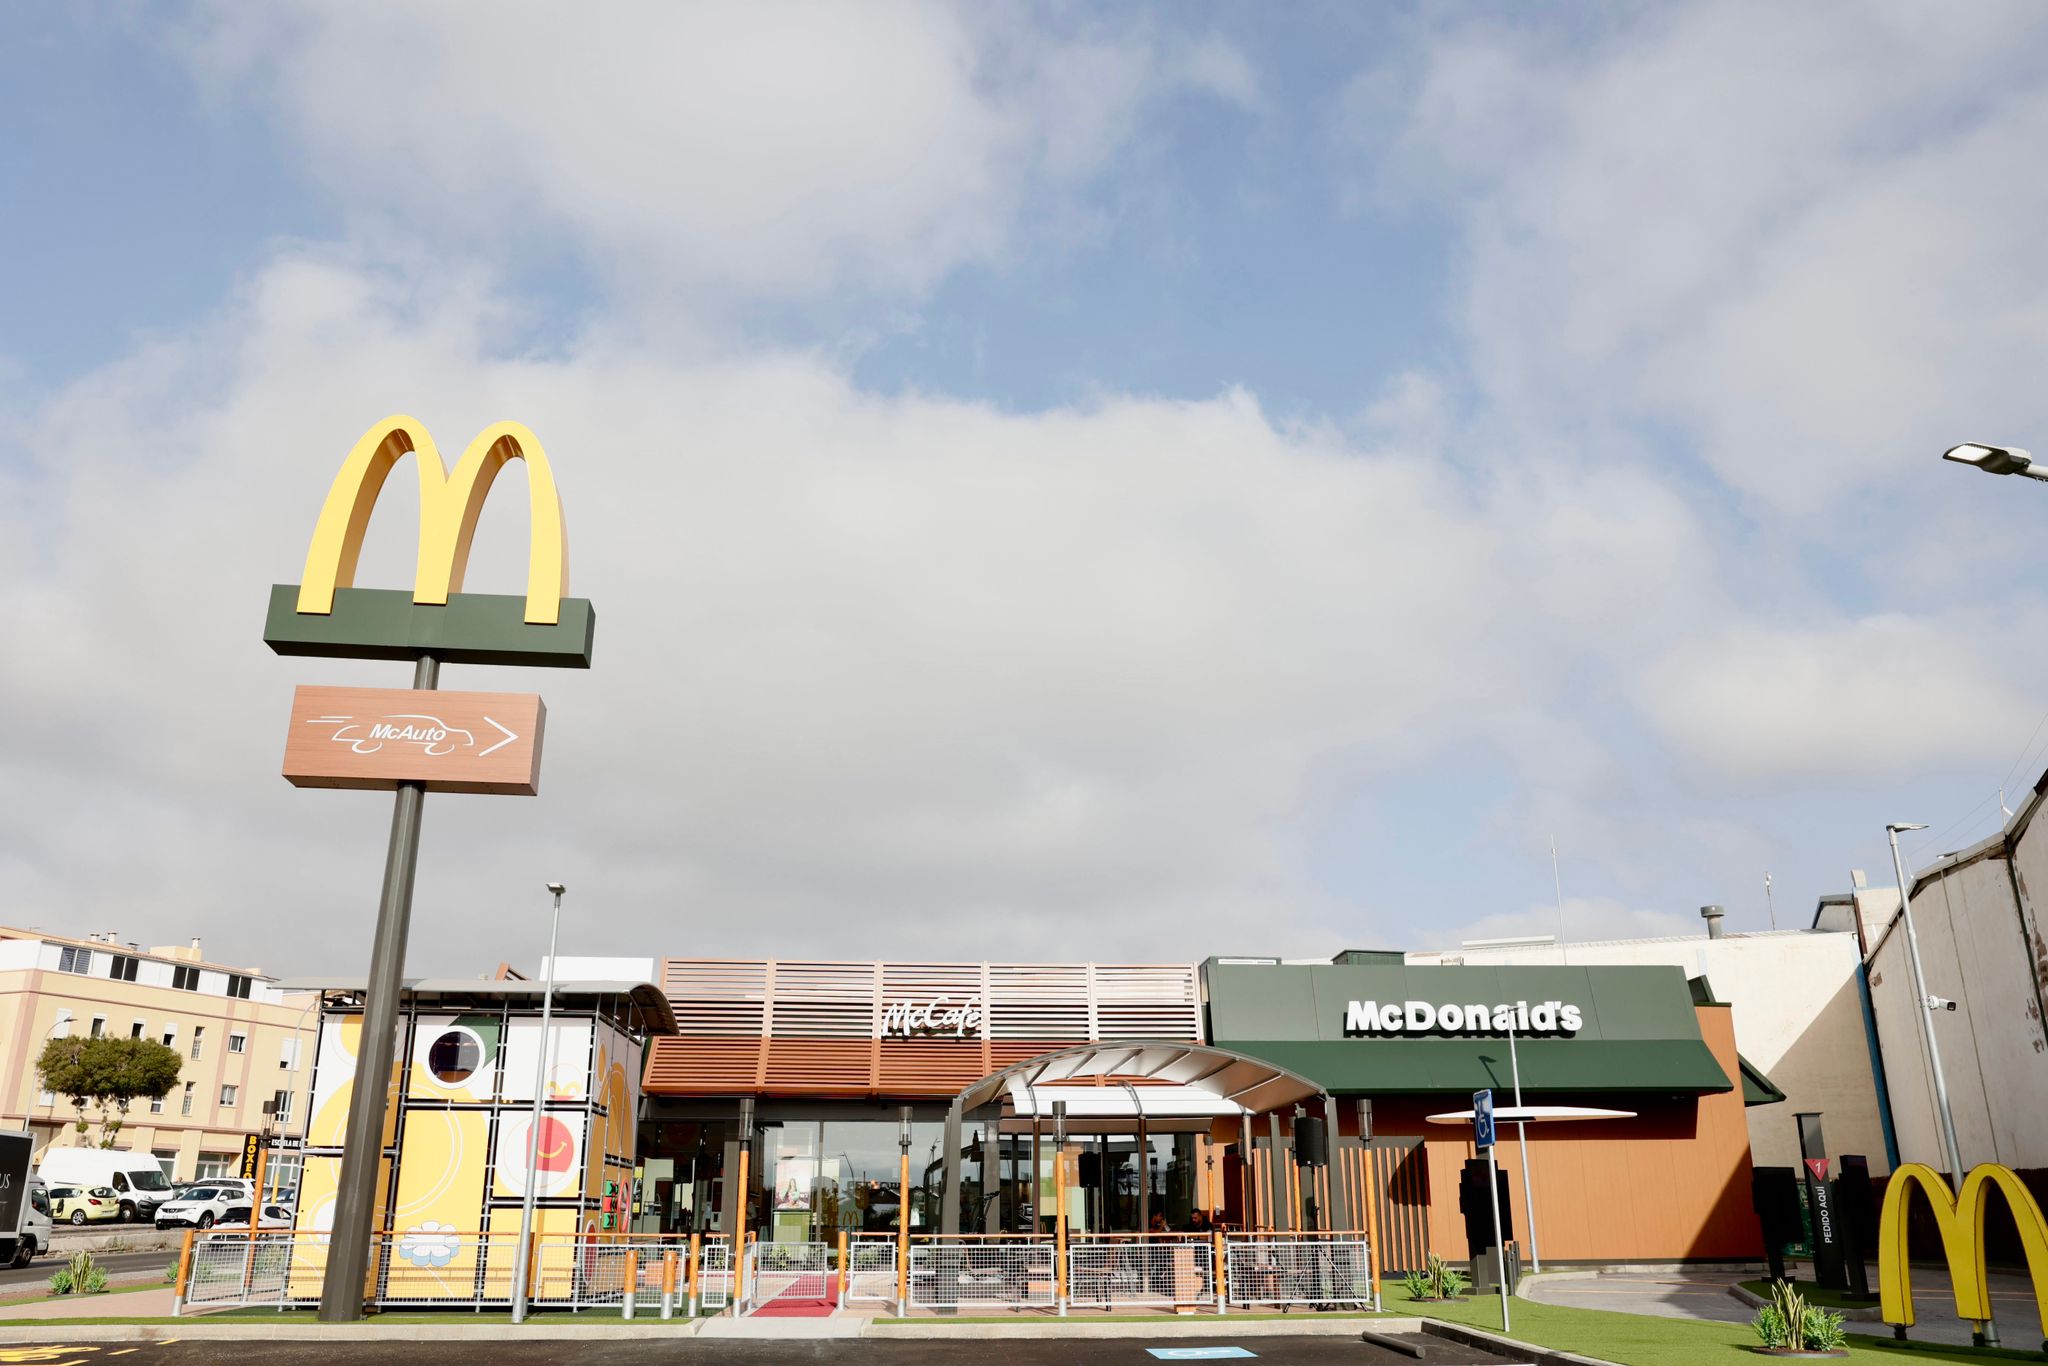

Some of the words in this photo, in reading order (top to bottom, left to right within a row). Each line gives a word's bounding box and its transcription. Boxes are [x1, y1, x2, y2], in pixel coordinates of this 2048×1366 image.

[369, 723, 447, 742] McAuto
[1346, 1000, 1583, 1032] McDonald's
[1815, 1162, 1821, 1173] 1
[1820, 1209, 1832, 1243] PEDIDO
